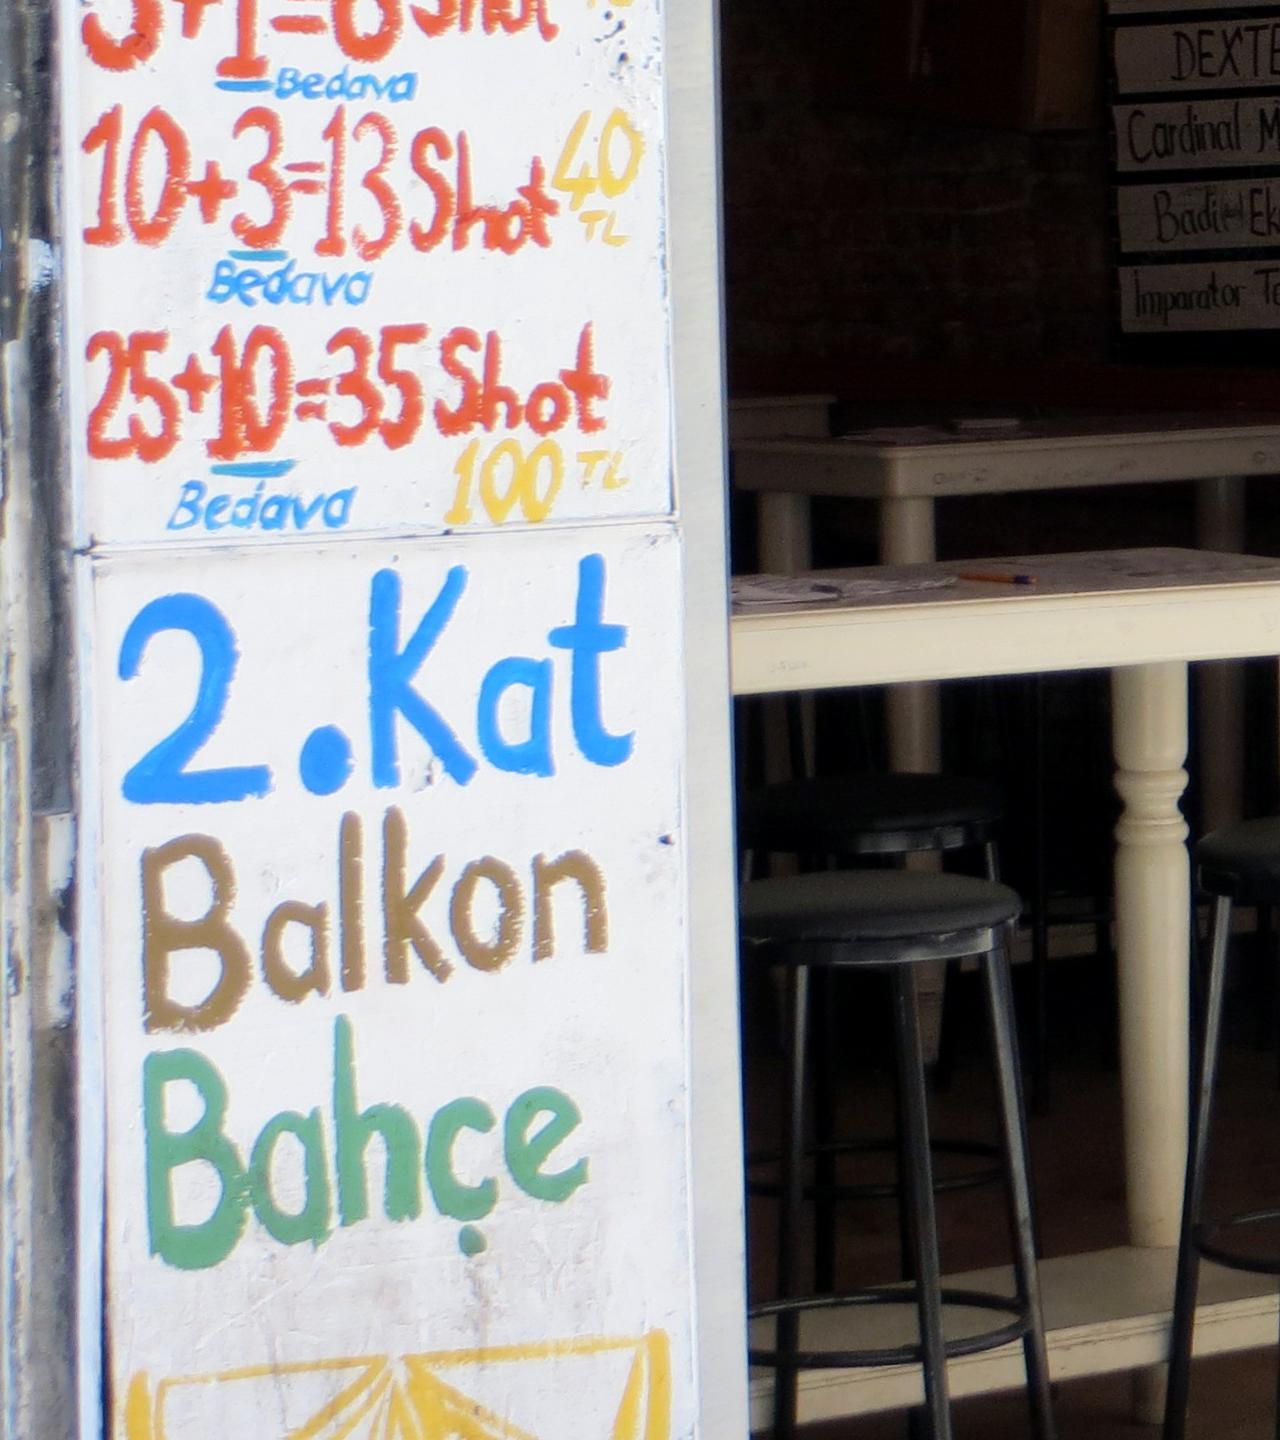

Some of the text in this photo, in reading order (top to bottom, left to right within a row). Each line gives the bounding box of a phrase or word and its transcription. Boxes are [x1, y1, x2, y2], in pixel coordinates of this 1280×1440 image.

[275, 66, 419, 103] Bedava
[551, 107, 646, 210] 40
[1127, 102, 1242, 163] Cardinal
[582, 210, 631, 246] TL
[206, 259, 373, 307] Bedava
[166, 436, 631, 532] Bedava 100 TL
[140, 804, 609, 1035] Balkon
[142, 1013, 592, 1272] Bahçe
